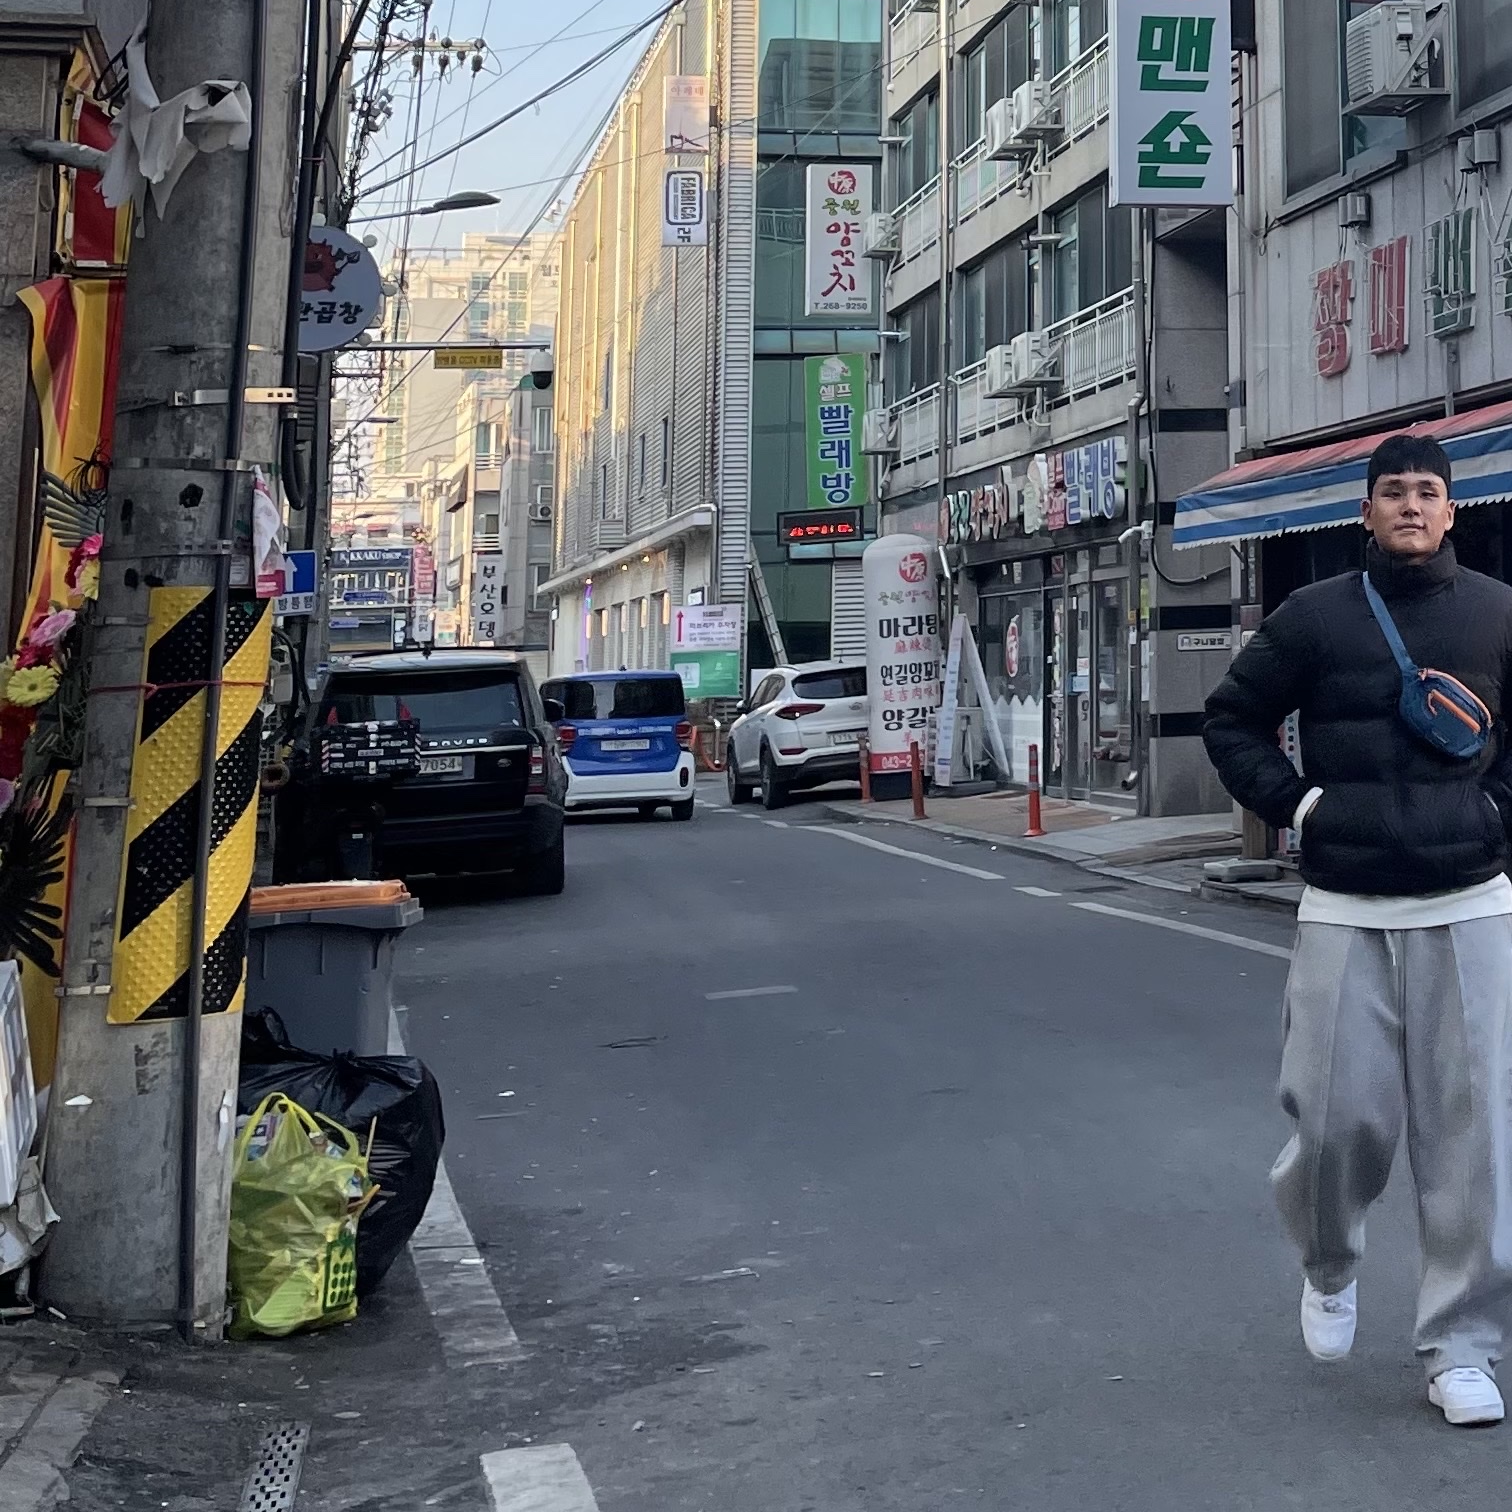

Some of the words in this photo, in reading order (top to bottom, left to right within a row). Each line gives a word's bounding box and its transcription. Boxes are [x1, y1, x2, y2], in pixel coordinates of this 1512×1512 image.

[680, 176, 697, 221] FABRICA
[821, 197, 861, 216] 중원
[676, 227, 692, 243] 2F
[820, 221, 861, 297] 양꼬치
[820, 383, 852, 402] 셀프
[819, 403, 855, 504] 빨래방
[1064, 438, 1119, 525] 빨래방
[479, 565, 496, 638] 부산오뎅
[422, 757, 456, 772] 7054
